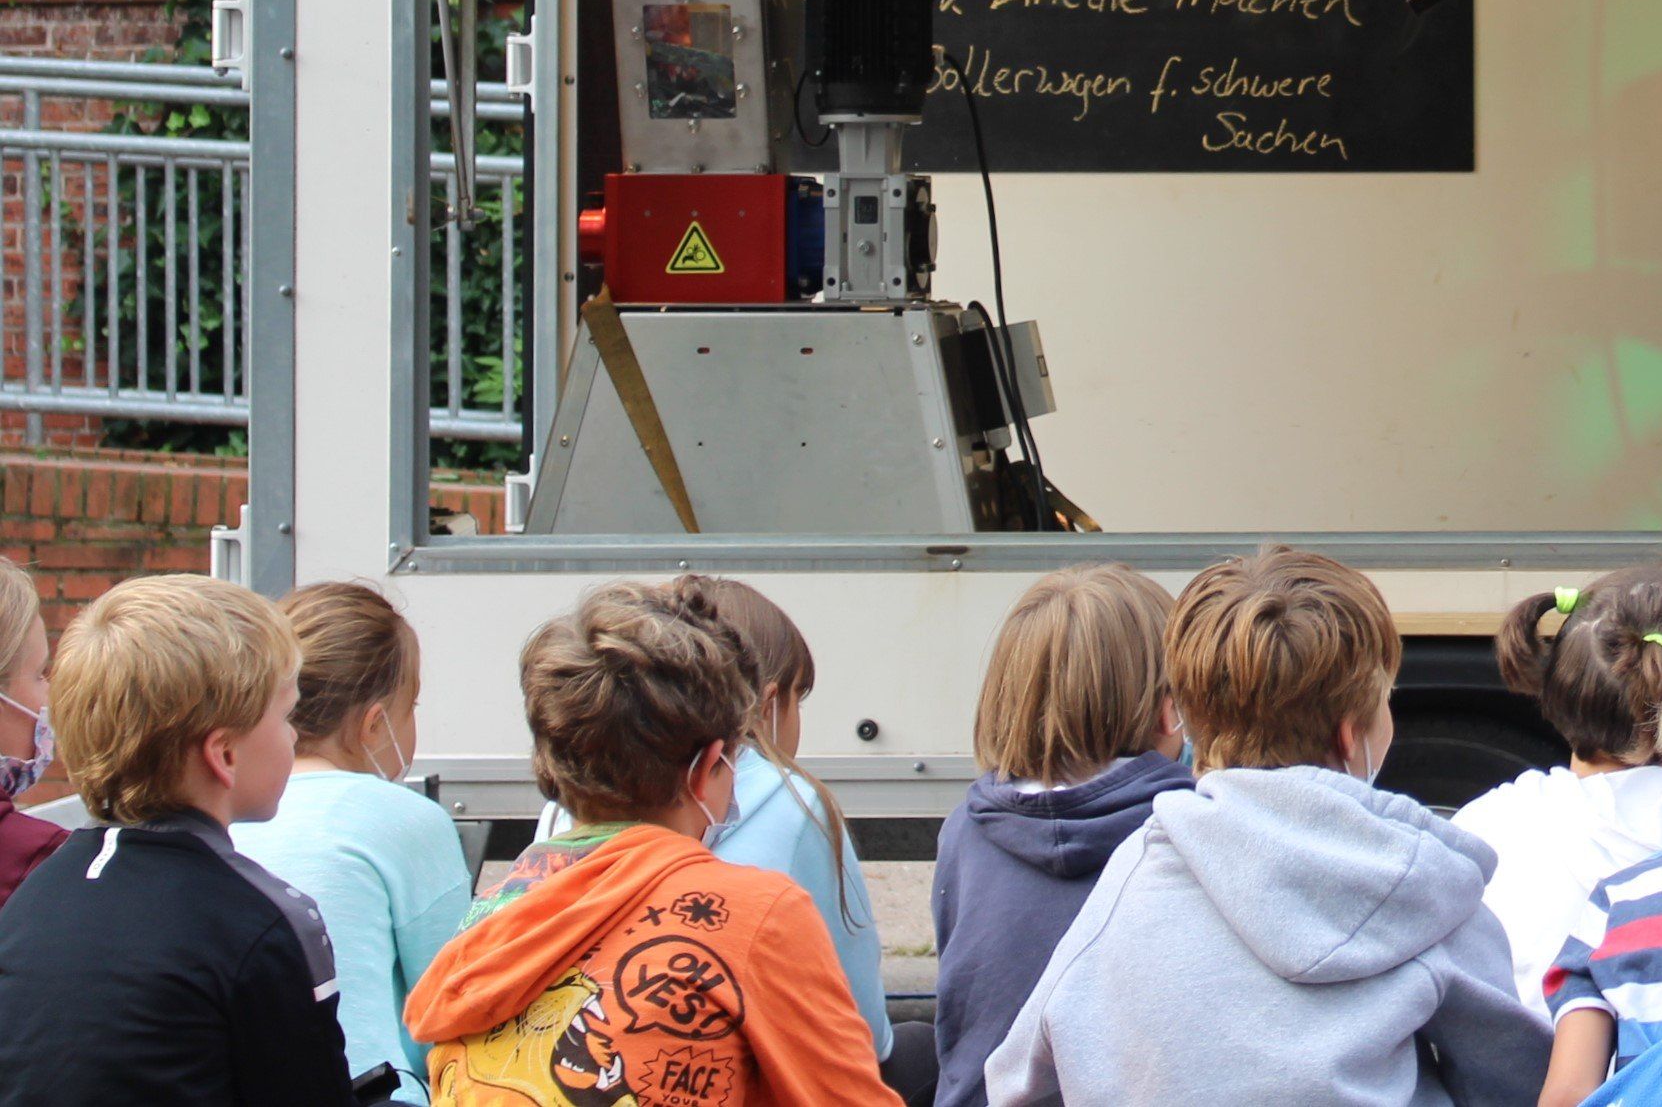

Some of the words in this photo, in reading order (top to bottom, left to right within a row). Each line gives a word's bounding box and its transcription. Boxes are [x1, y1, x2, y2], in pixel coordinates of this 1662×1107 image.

[1149, 55, 1182, 114] f.
[1190, 57, 1334, 99] schwere
[1201, 111, 1348, 161] Sachen
[667, 952, 726, 993] OH
[626, 963, 731, 1039] YES!
[659, 1059, 721, 1100] FACE
[662, 1093, 699, 1107] YOUR
